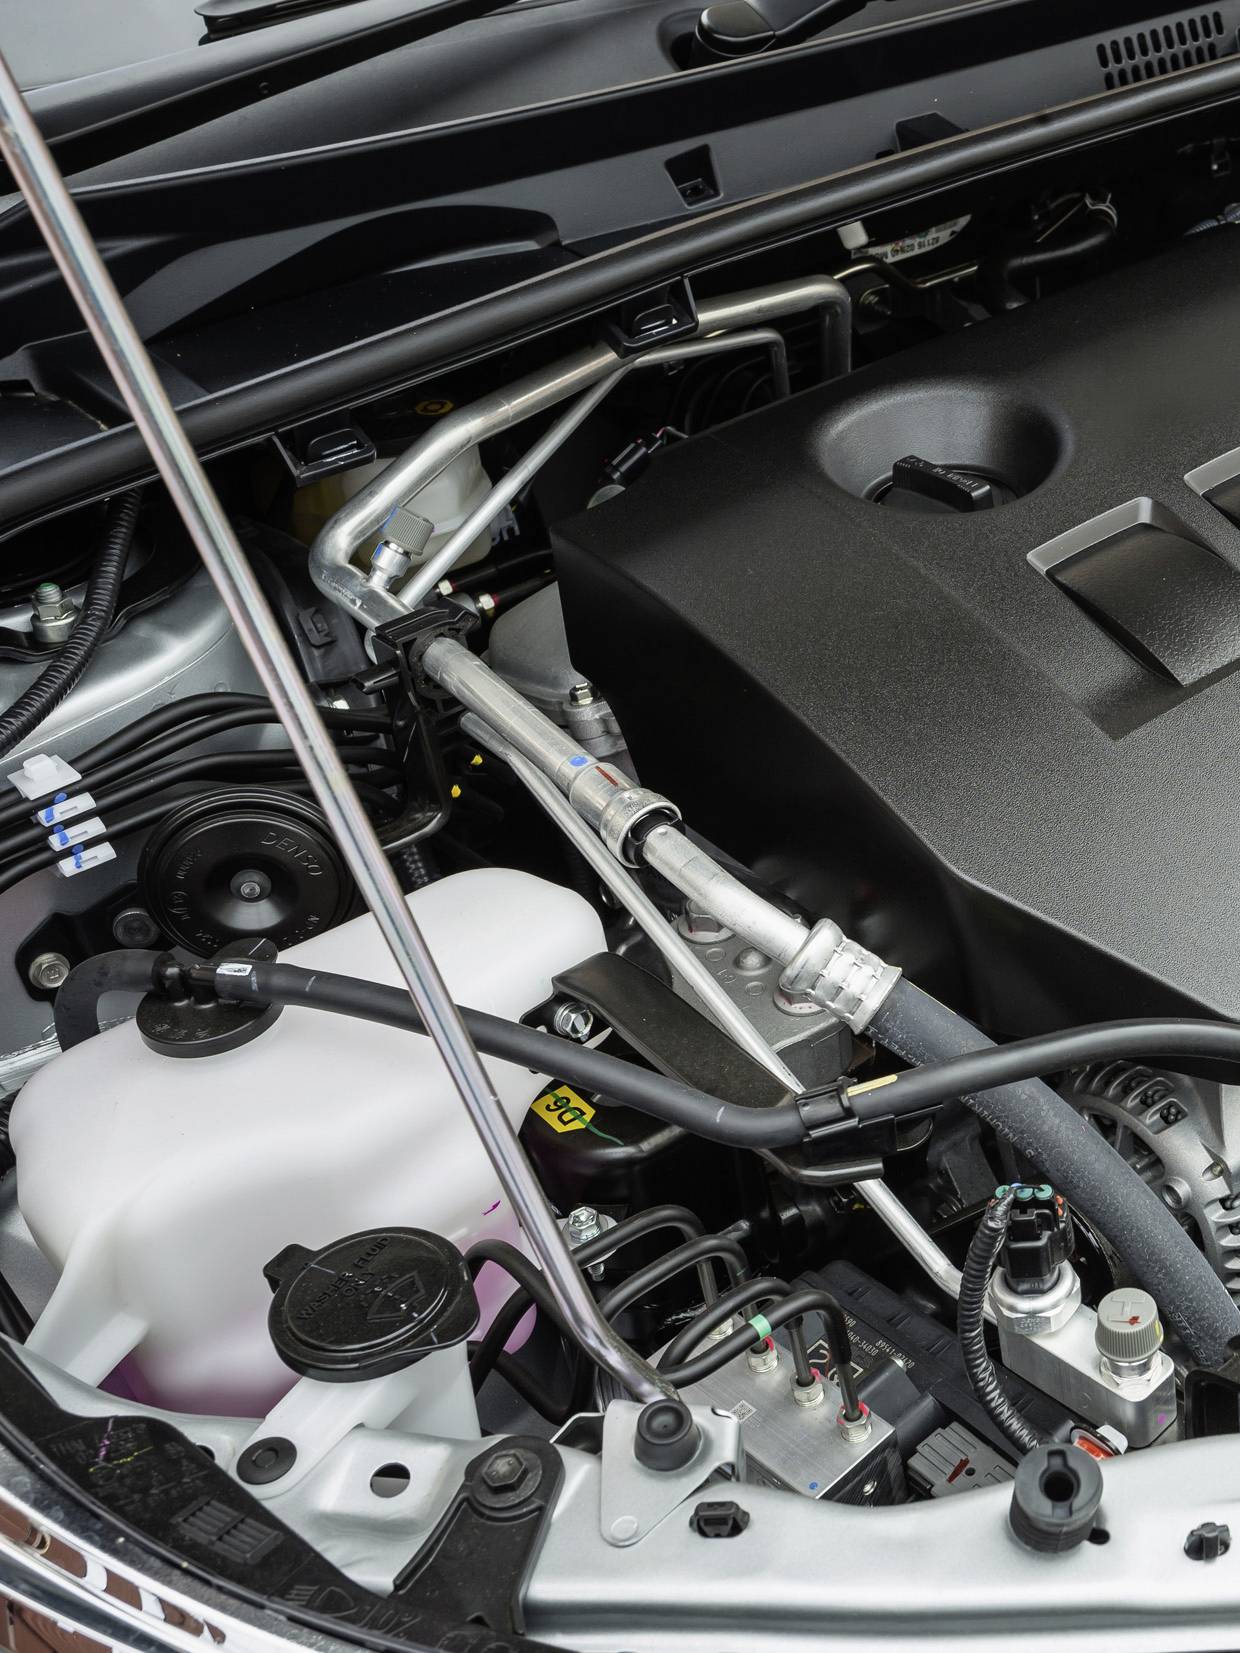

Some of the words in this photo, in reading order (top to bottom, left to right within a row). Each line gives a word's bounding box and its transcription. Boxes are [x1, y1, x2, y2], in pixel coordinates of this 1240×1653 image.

[261, 832, 323, 876] DENSO
[299, 1271, 352, 1320] WASHER
[353, 1237, 391, 1269] FLUID
[344, 1271, 376, 1297] ONLY
